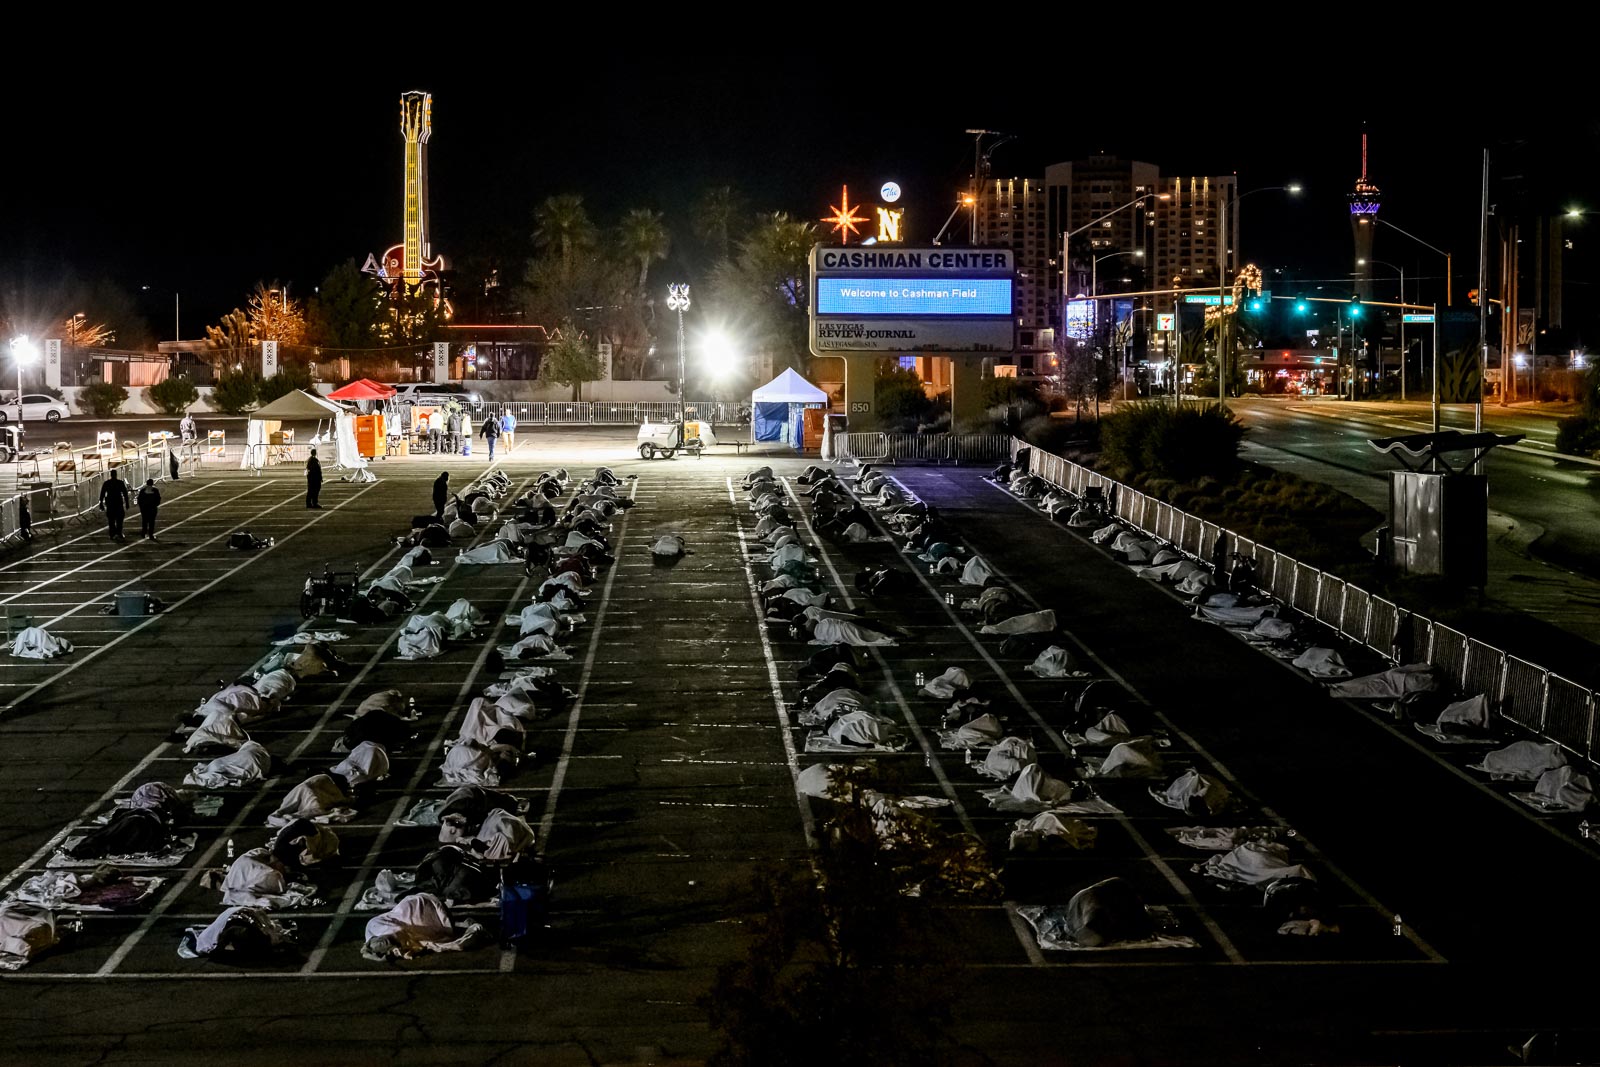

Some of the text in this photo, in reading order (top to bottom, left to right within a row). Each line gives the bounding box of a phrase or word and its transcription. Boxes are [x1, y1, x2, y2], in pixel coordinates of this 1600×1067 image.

[882, 187, 897, 197] The
[876, 207, 904, 242] N
[823, 252, 1007, 269] CASHMAN CENTER
[840, 288, 977, 298] Welcome to Cashman Field
[819, 323, 865, 331] LAS VEGAS
[818, 330, 916, 339] REVIEW-JOURNAL
[852, 402, 869, 412] 850
